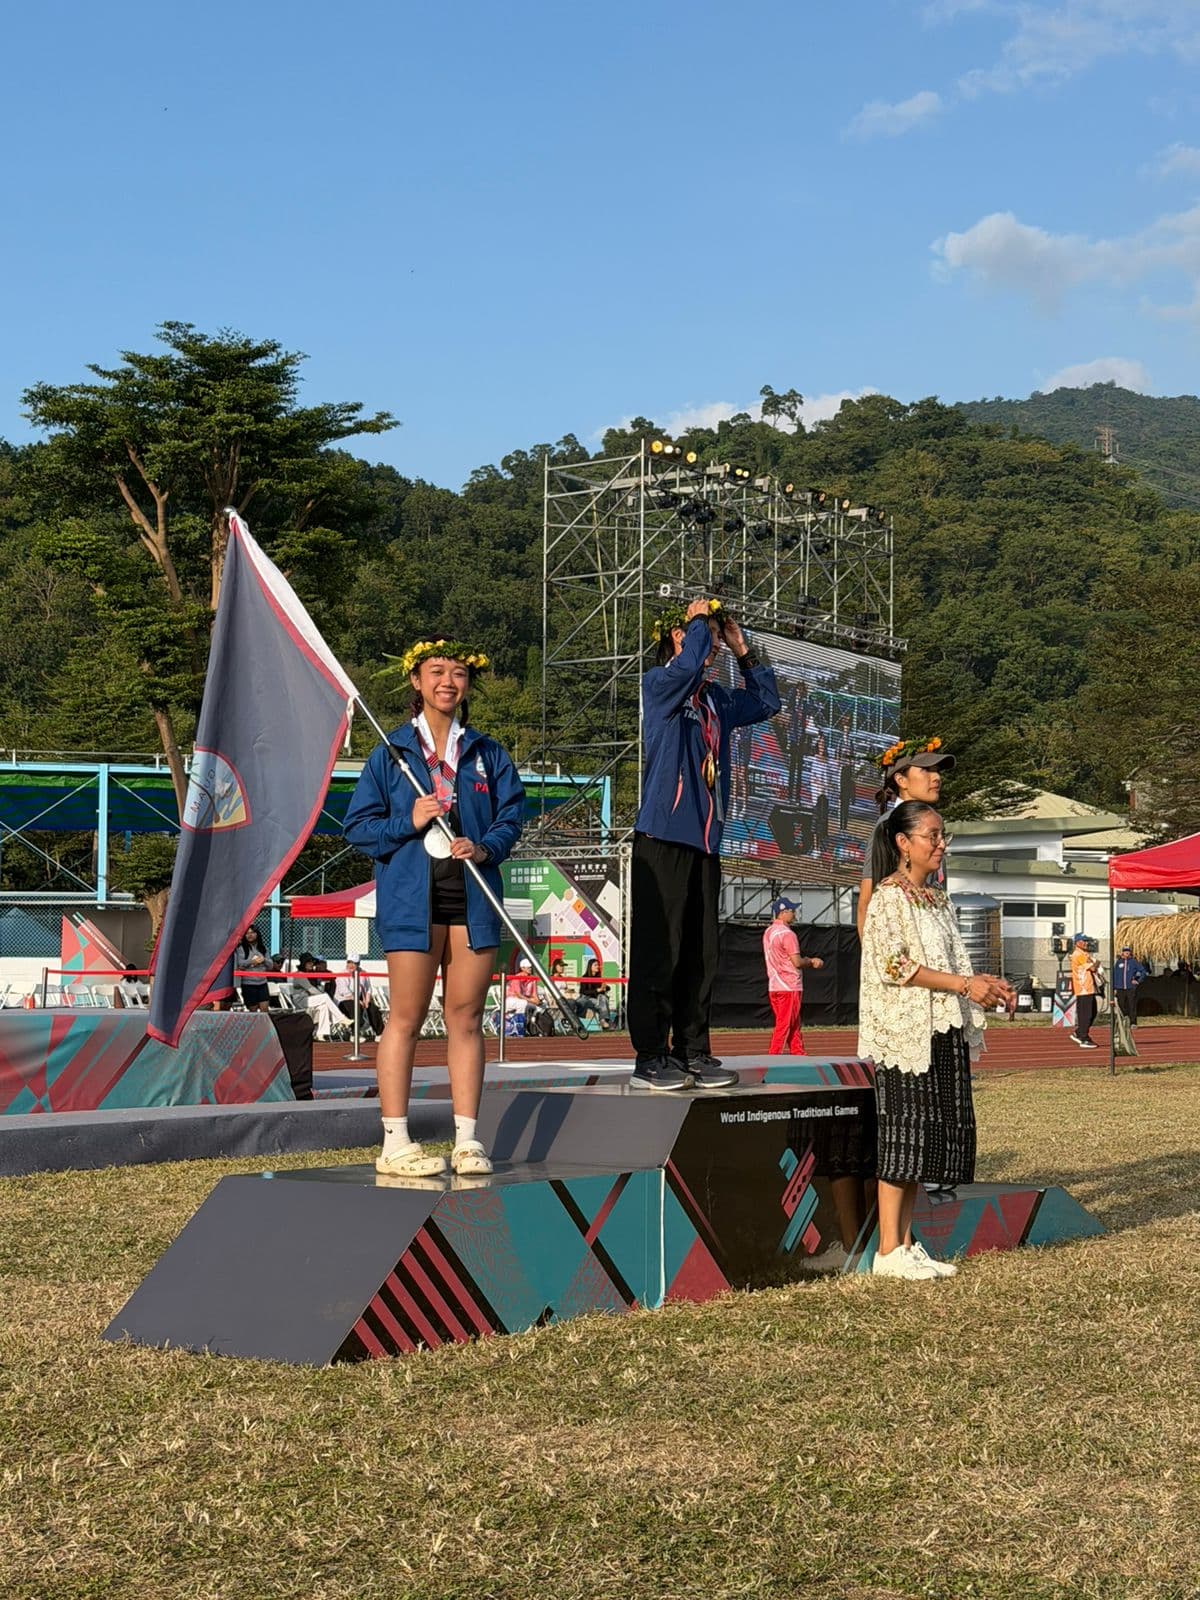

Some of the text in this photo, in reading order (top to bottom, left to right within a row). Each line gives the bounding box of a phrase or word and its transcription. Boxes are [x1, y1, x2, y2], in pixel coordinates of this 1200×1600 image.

[720, 1105, 859, 1123] World Indigenous Traditional Games
